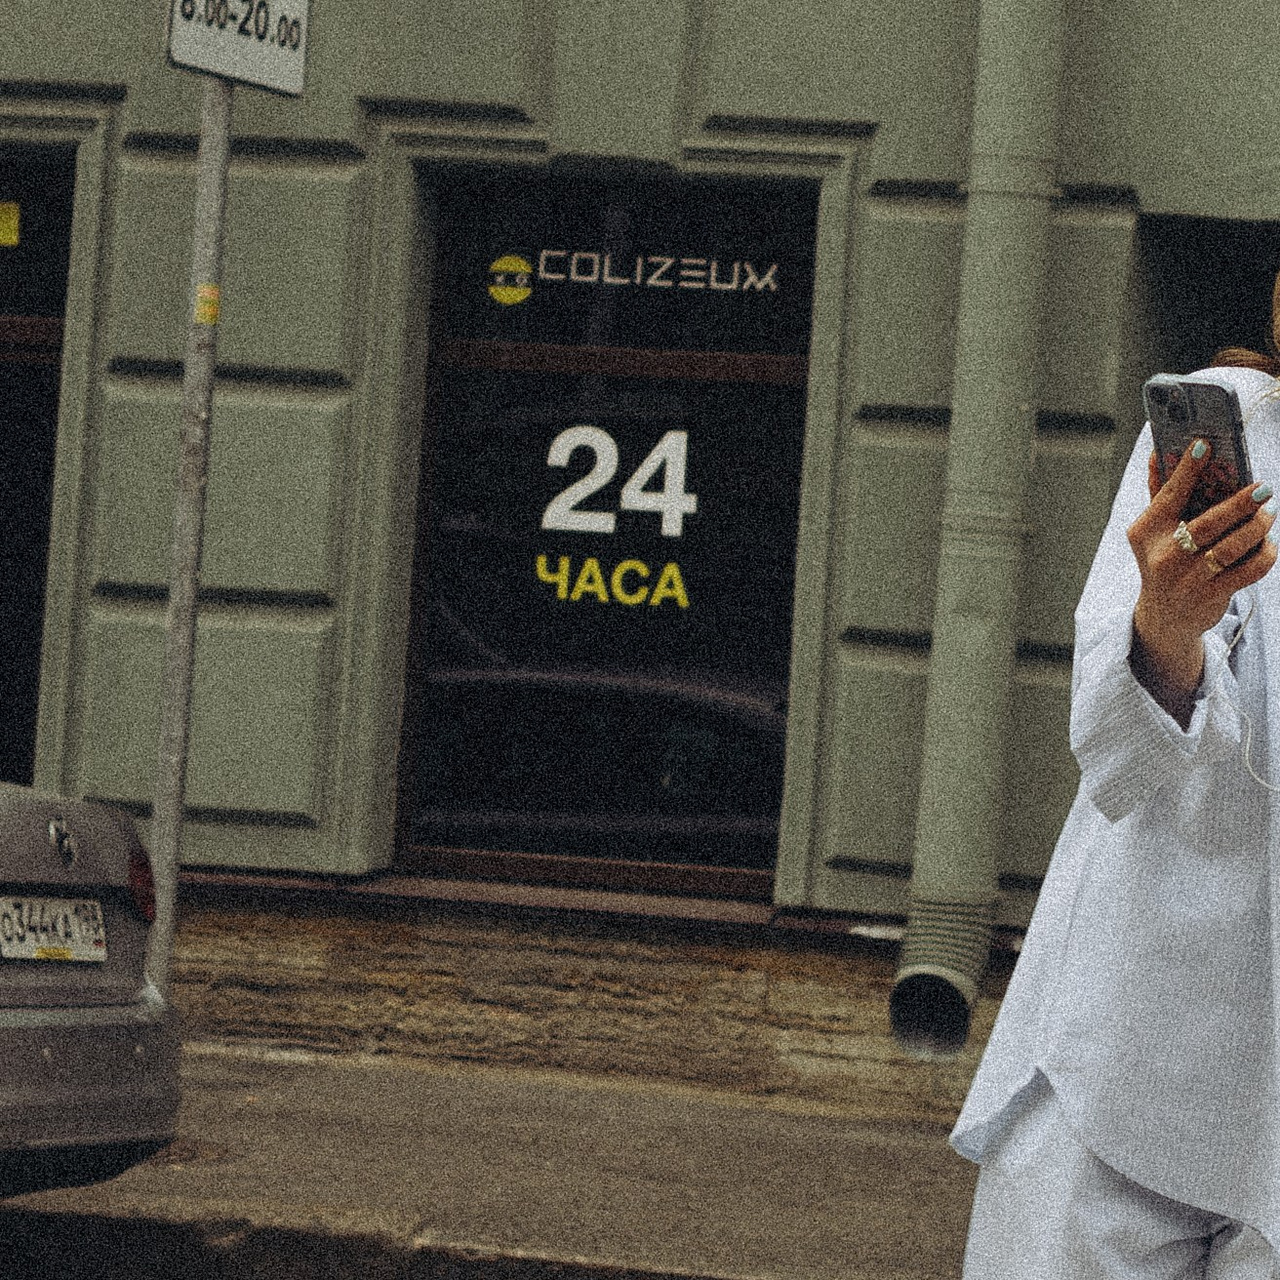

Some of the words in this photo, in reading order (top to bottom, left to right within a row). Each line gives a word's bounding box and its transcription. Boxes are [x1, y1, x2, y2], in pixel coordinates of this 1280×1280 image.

[537, 248, 780, 292] COLIZEUM
[541, 425, 698, 538] 24
[535, 553, 690, 609] ЧАСА
